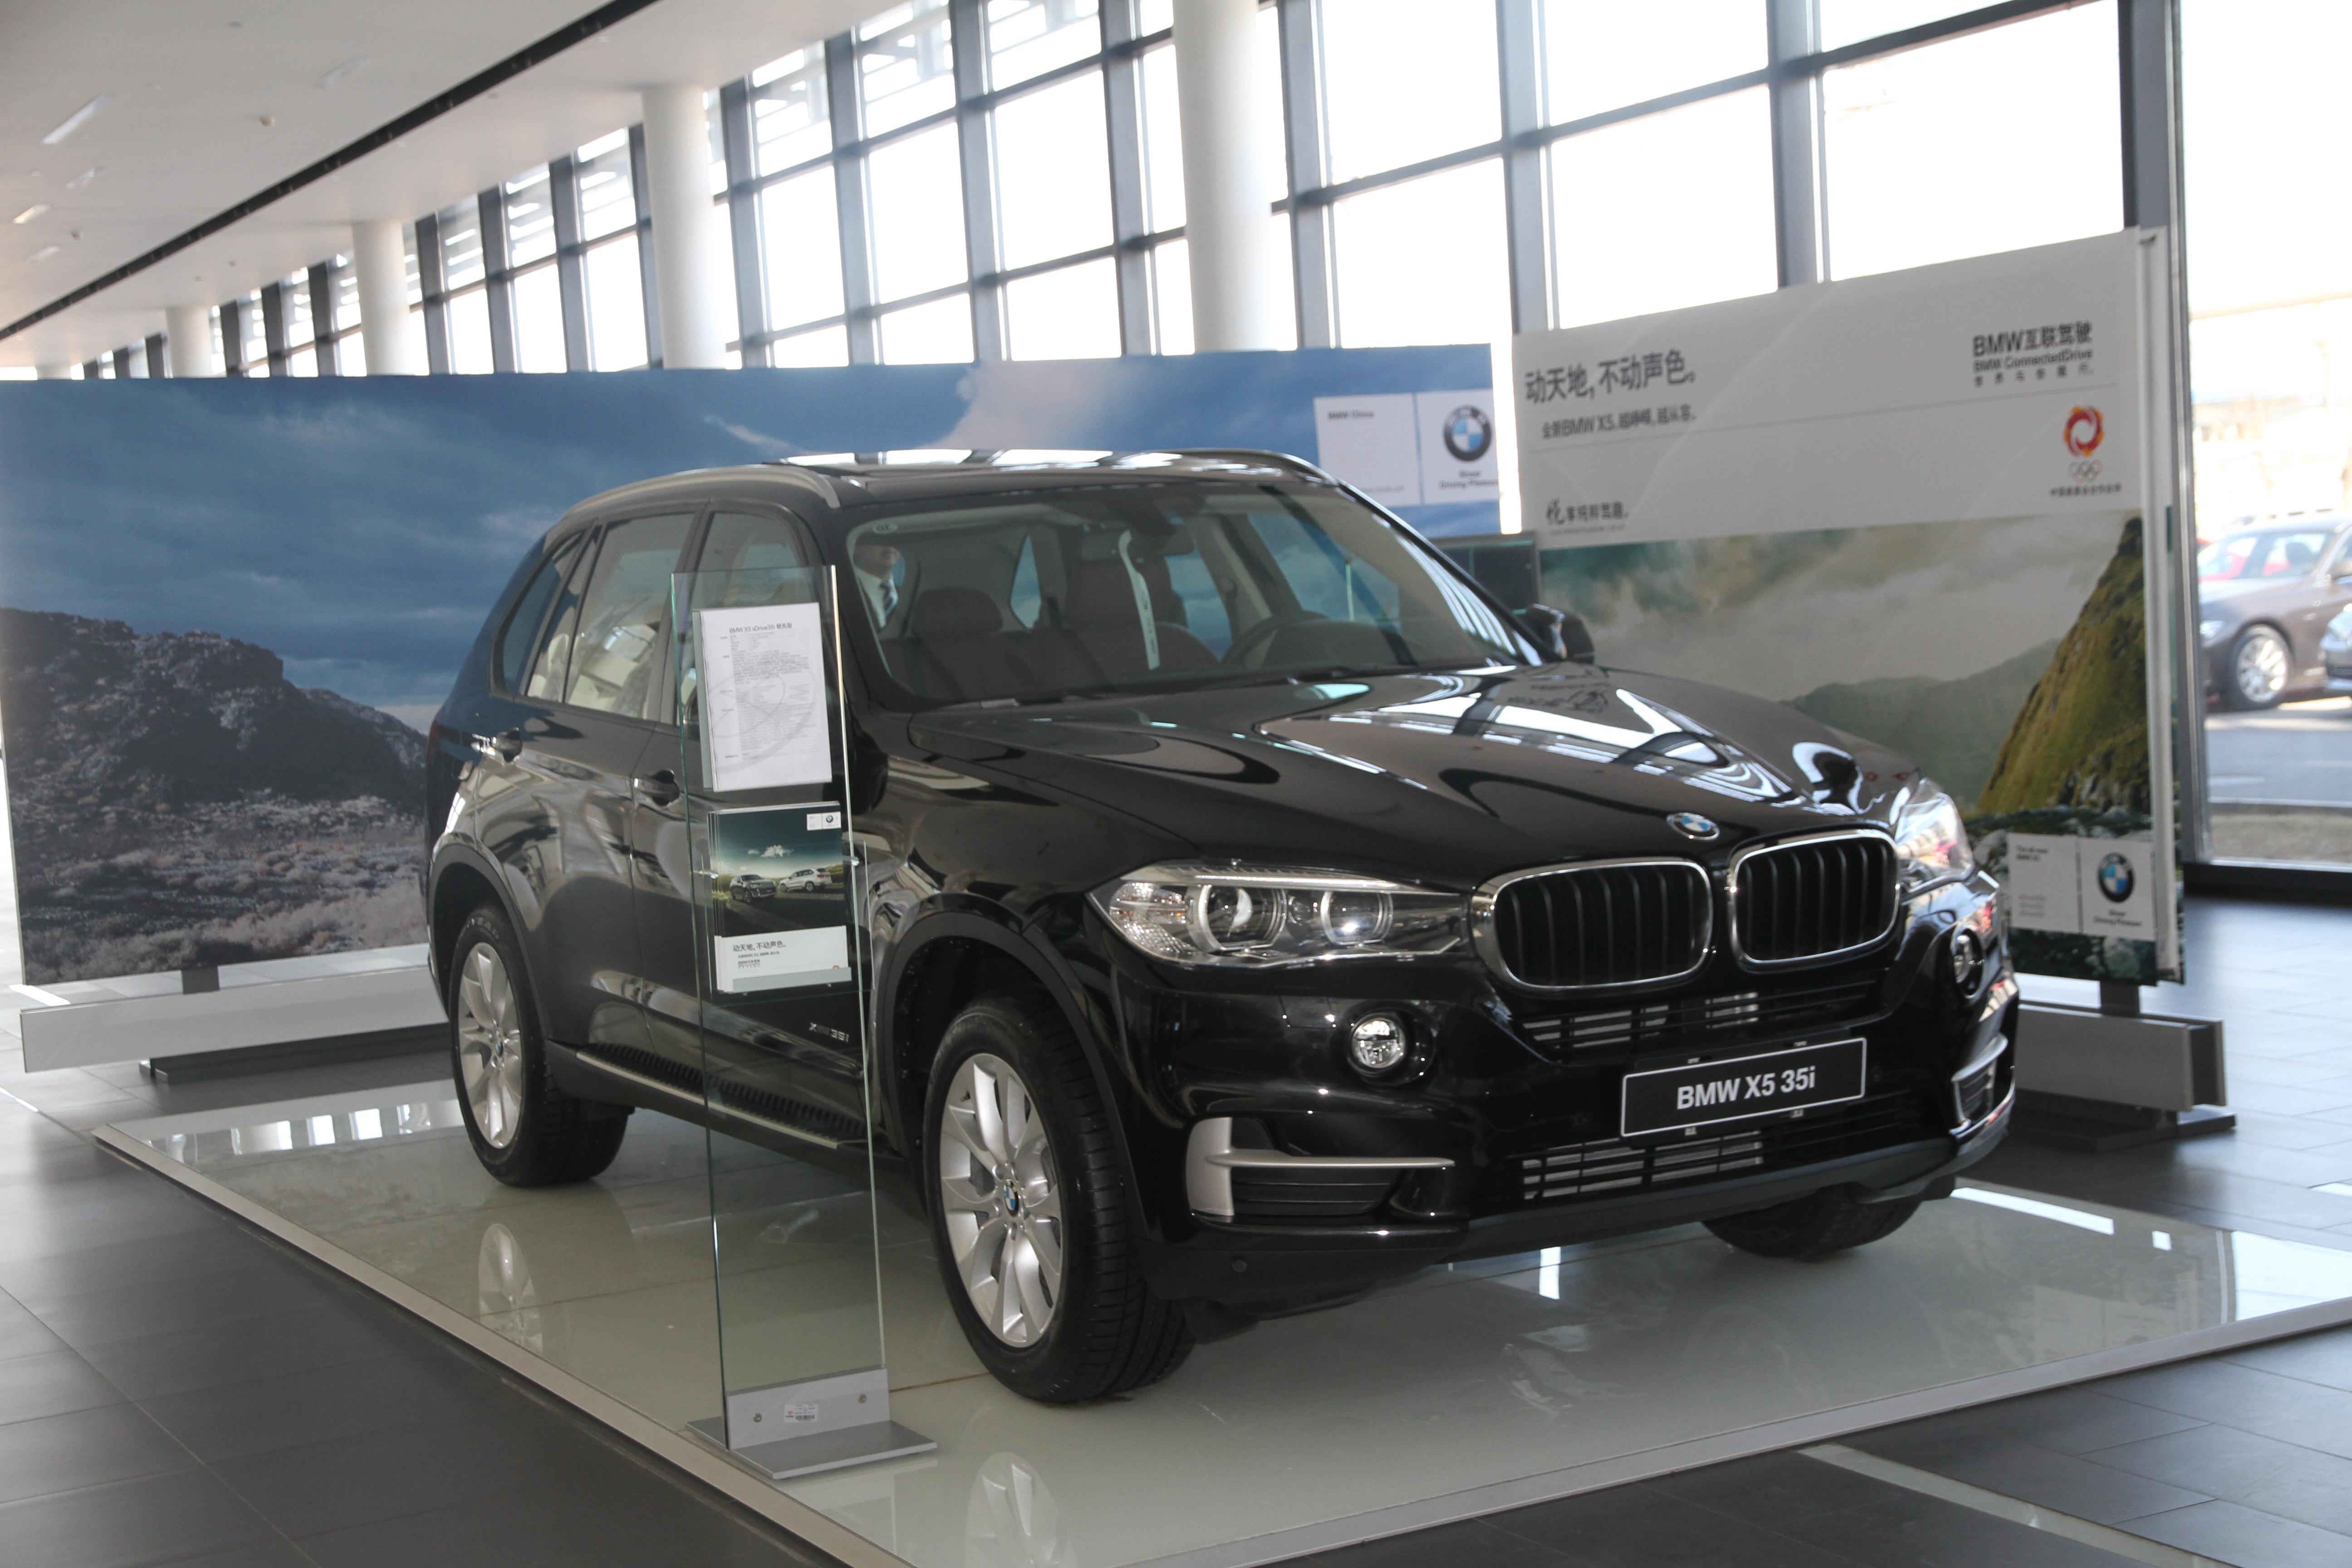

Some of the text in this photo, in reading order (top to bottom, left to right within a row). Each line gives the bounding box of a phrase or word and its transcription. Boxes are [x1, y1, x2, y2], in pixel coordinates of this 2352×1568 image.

[1974, 320, 2092, 357] BMW互联驾驶
[1975, 359, 2000, 372] BMW
[1677, 1066, 1816, 1109] BMW X5 35i
